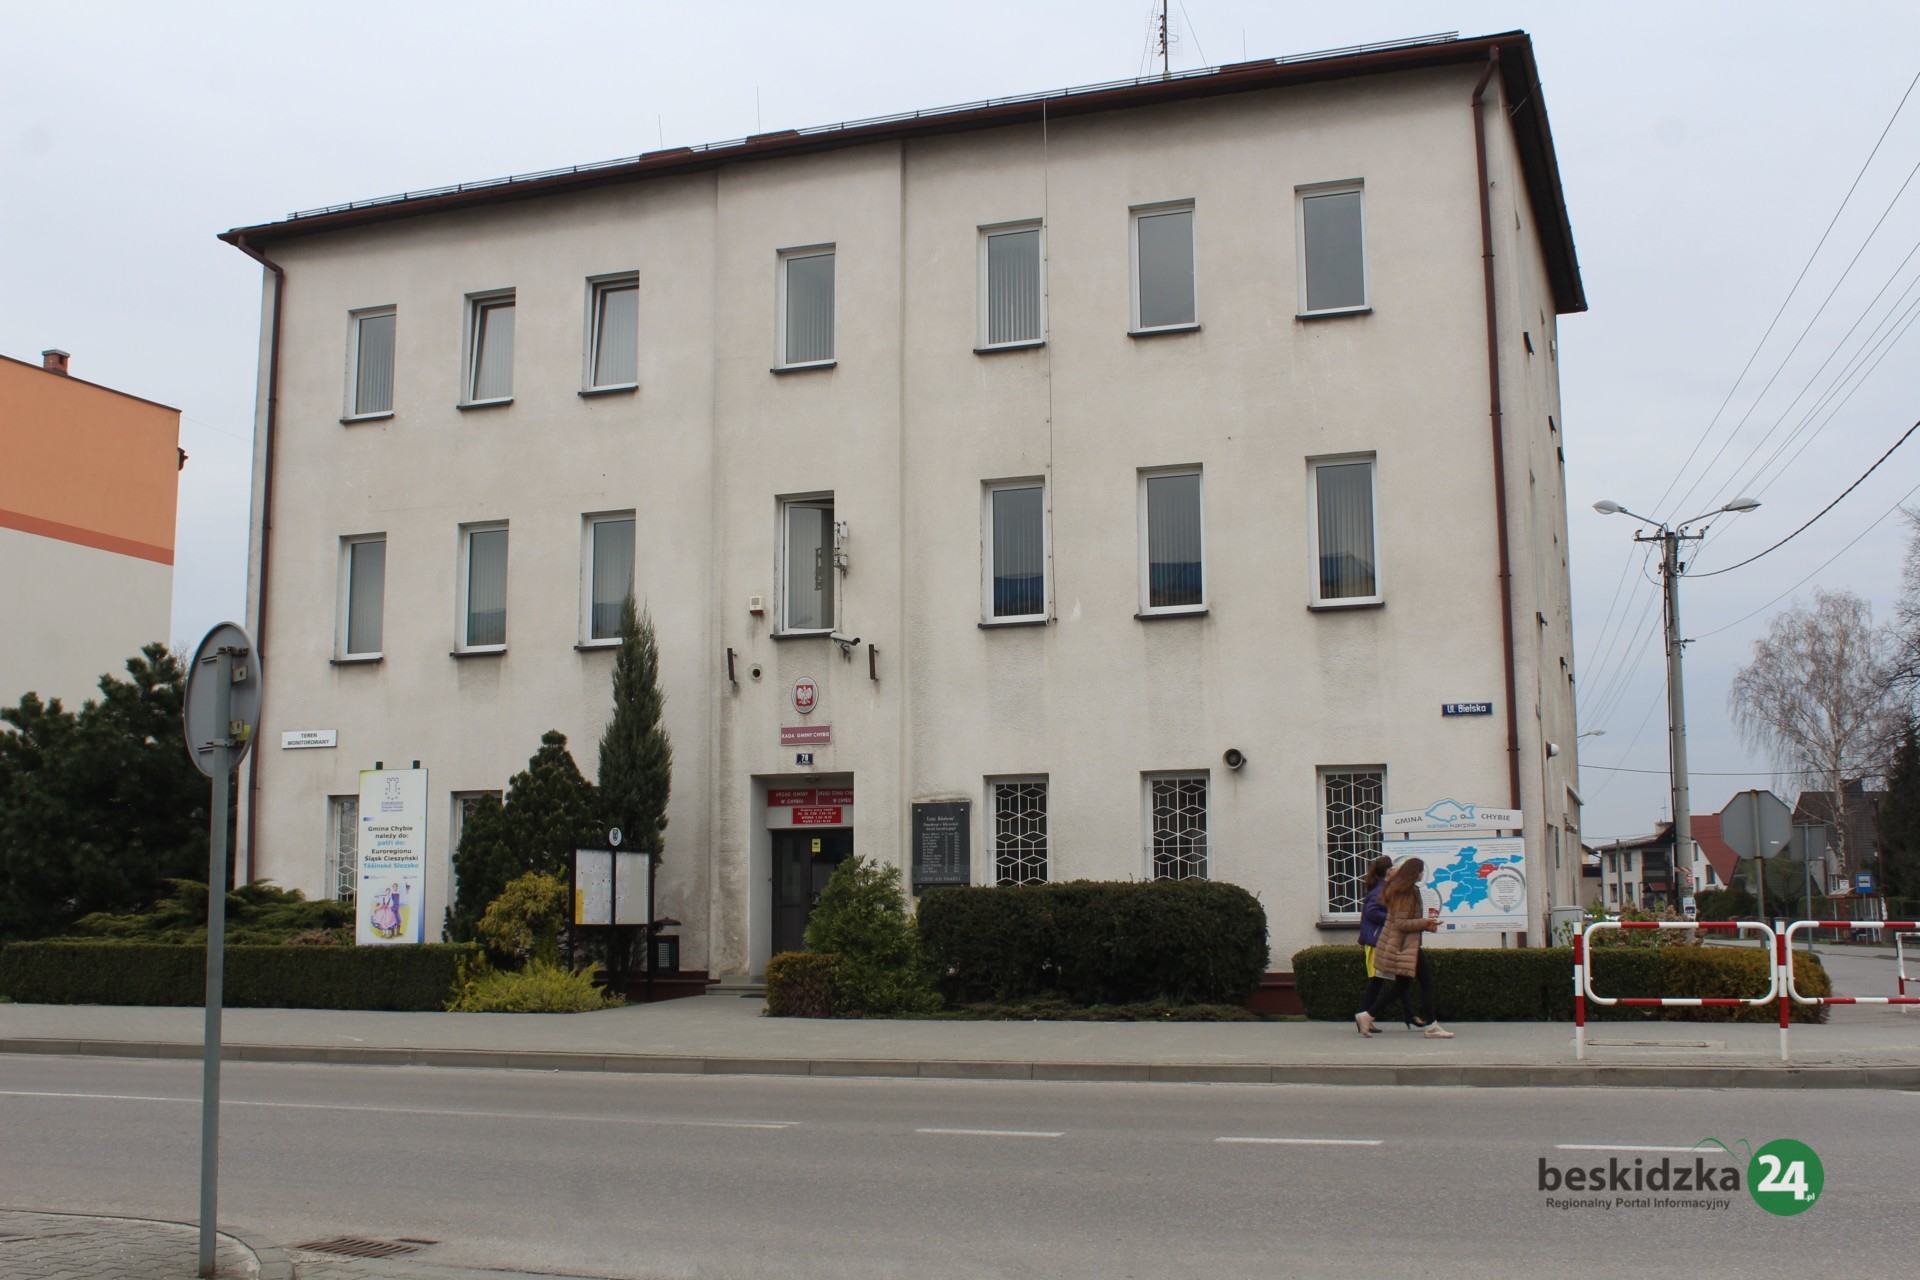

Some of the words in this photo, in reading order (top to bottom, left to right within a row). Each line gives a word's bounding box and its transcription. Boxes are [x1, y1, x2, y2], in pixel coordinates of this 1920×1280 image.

[1458, 704, 1487, 713] Bielska
[1395, 816, 1423, 825] GMINA
[1481, 813, 1511, 821] CHYBIE
[1450, 821, 1477, 829] karpia
